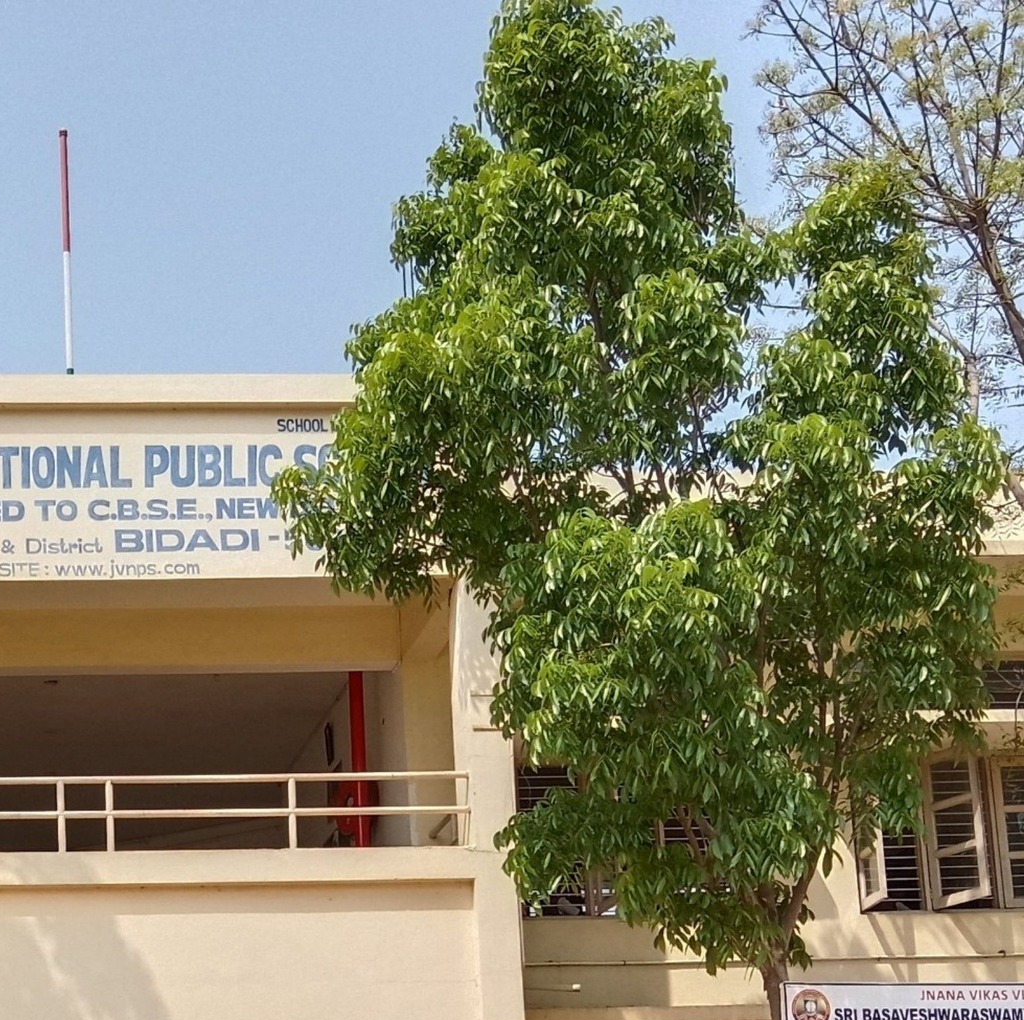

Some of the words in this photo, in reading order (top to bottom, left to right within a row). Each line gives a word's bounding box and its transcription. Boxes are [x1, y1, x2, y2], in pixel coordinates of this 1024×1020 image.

[277, 418, 328, 433] SCHOOL
[144, 444, 283, 488] PUBLIC
[34, 499, 78, 521] TO
[0, 539, 15, 554] &
[25, 537, 103, 554] District
[114, 528, 260, 553] BIDADI
[55, 559, 200, 578] www.jvnps.com
[920, 989, 965, 1001] JNANA
[969, 989, 1008, 1001] VIKAS
